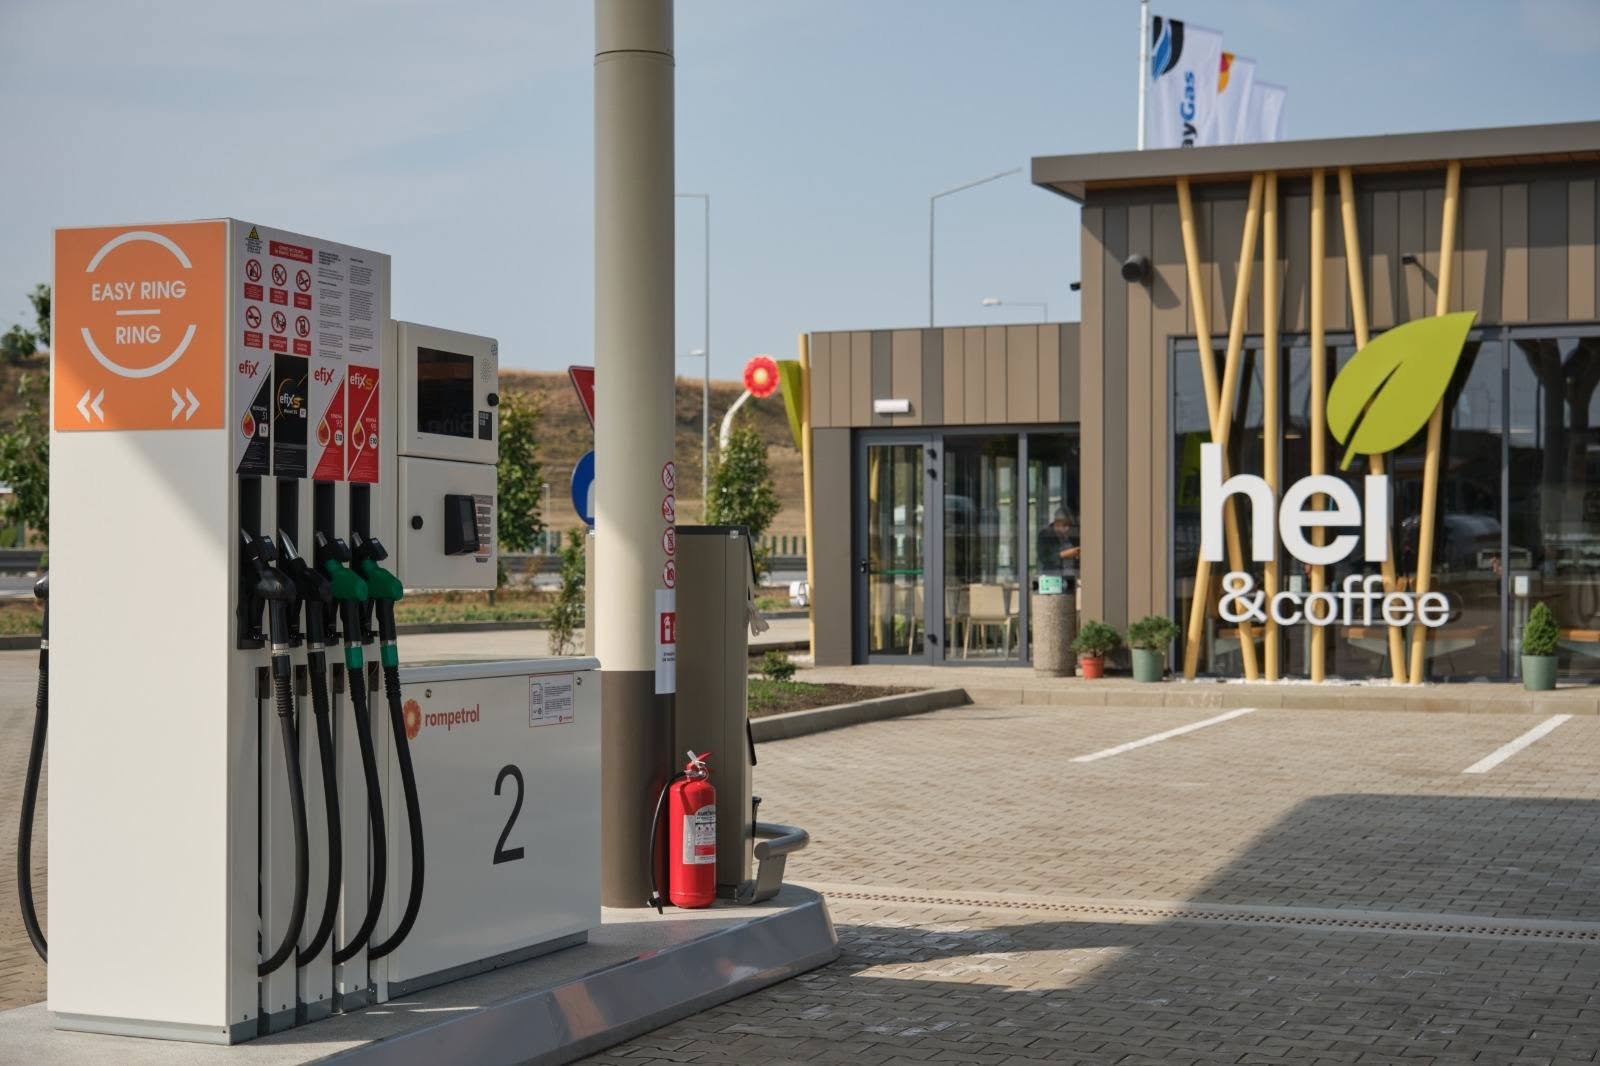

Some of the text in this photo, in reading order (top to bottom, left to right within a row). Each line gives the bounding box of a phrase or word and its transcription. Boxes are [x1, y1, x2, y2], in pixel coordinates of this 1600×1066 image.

[91, 280, 187, 301] EASY RING
[115, 325, 161, 345] RING
[238, 359, 259, 379] efix
[314, 367, 335, 386] efix
[1200, 443, 1389, 566] hei
[1218, 571, 1450, 628] &coffee
[424, 703, 480, 731] rompetrol
[492, 764, 525, 865] 2
